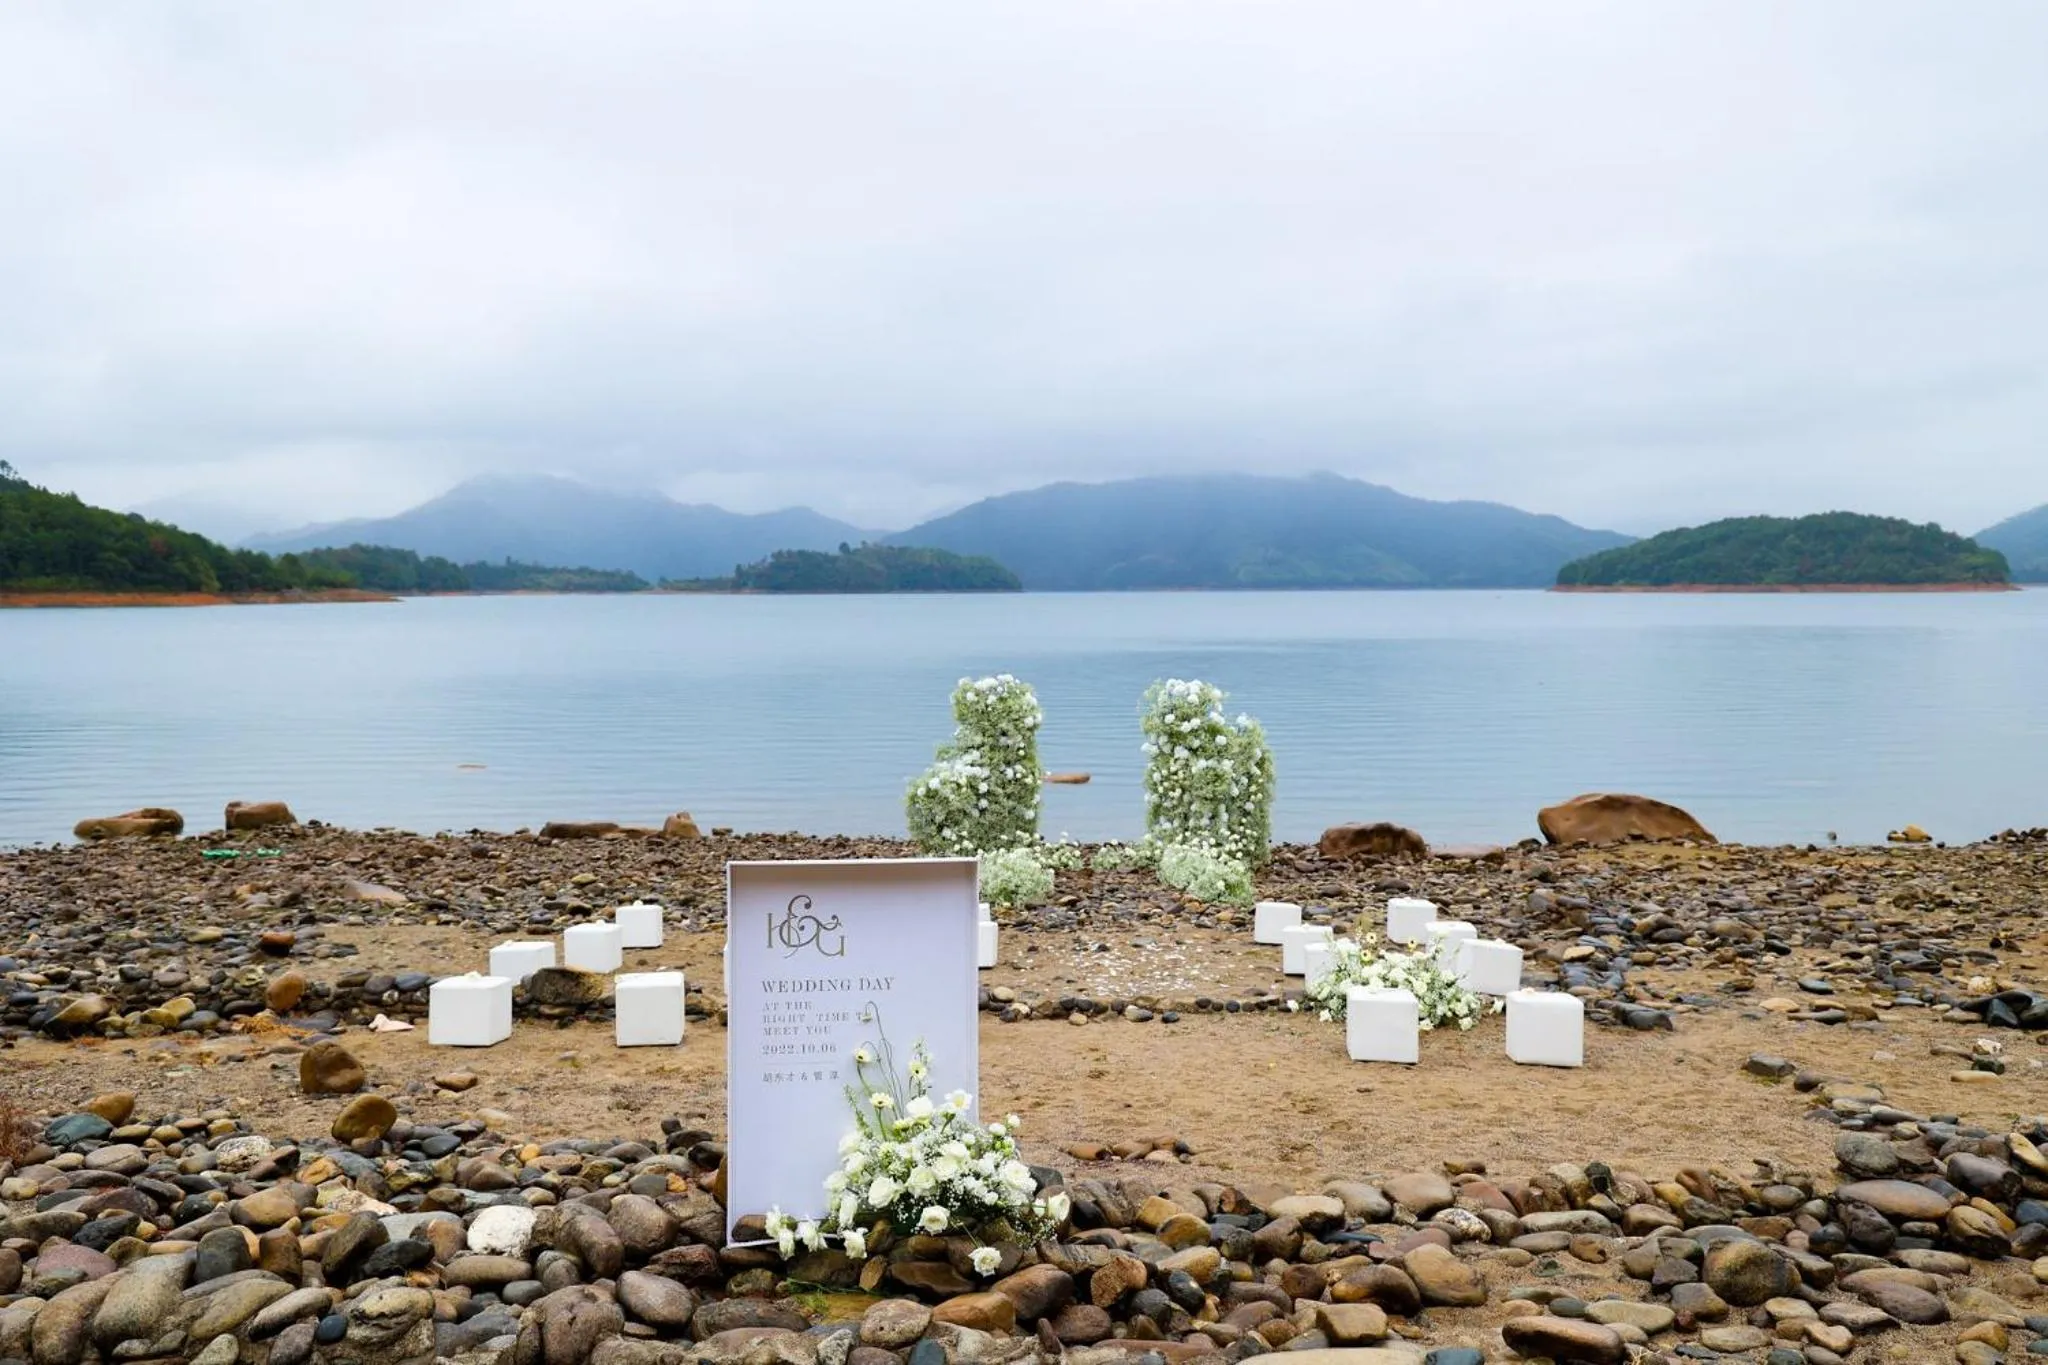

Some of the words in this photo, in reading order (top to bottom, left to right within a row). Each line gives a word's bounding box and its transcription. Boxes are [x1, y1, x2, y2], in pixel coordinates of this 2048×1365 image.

[762, 979, 851, 993] WEDDING
[859, 977, 894, 991] DAY
[763, 1001, 779, 1011] AT
[785, 1001, 812, 1011] THE
[763, 1013, 806, 1023] RIGHT
[816, 1012, 849, 1021] TIME
[763, 1026, 799, 1036] MEET
[806, 1025, 831, 1034] YOU
[762, 1044, 837, 1055] 2022.10.06
